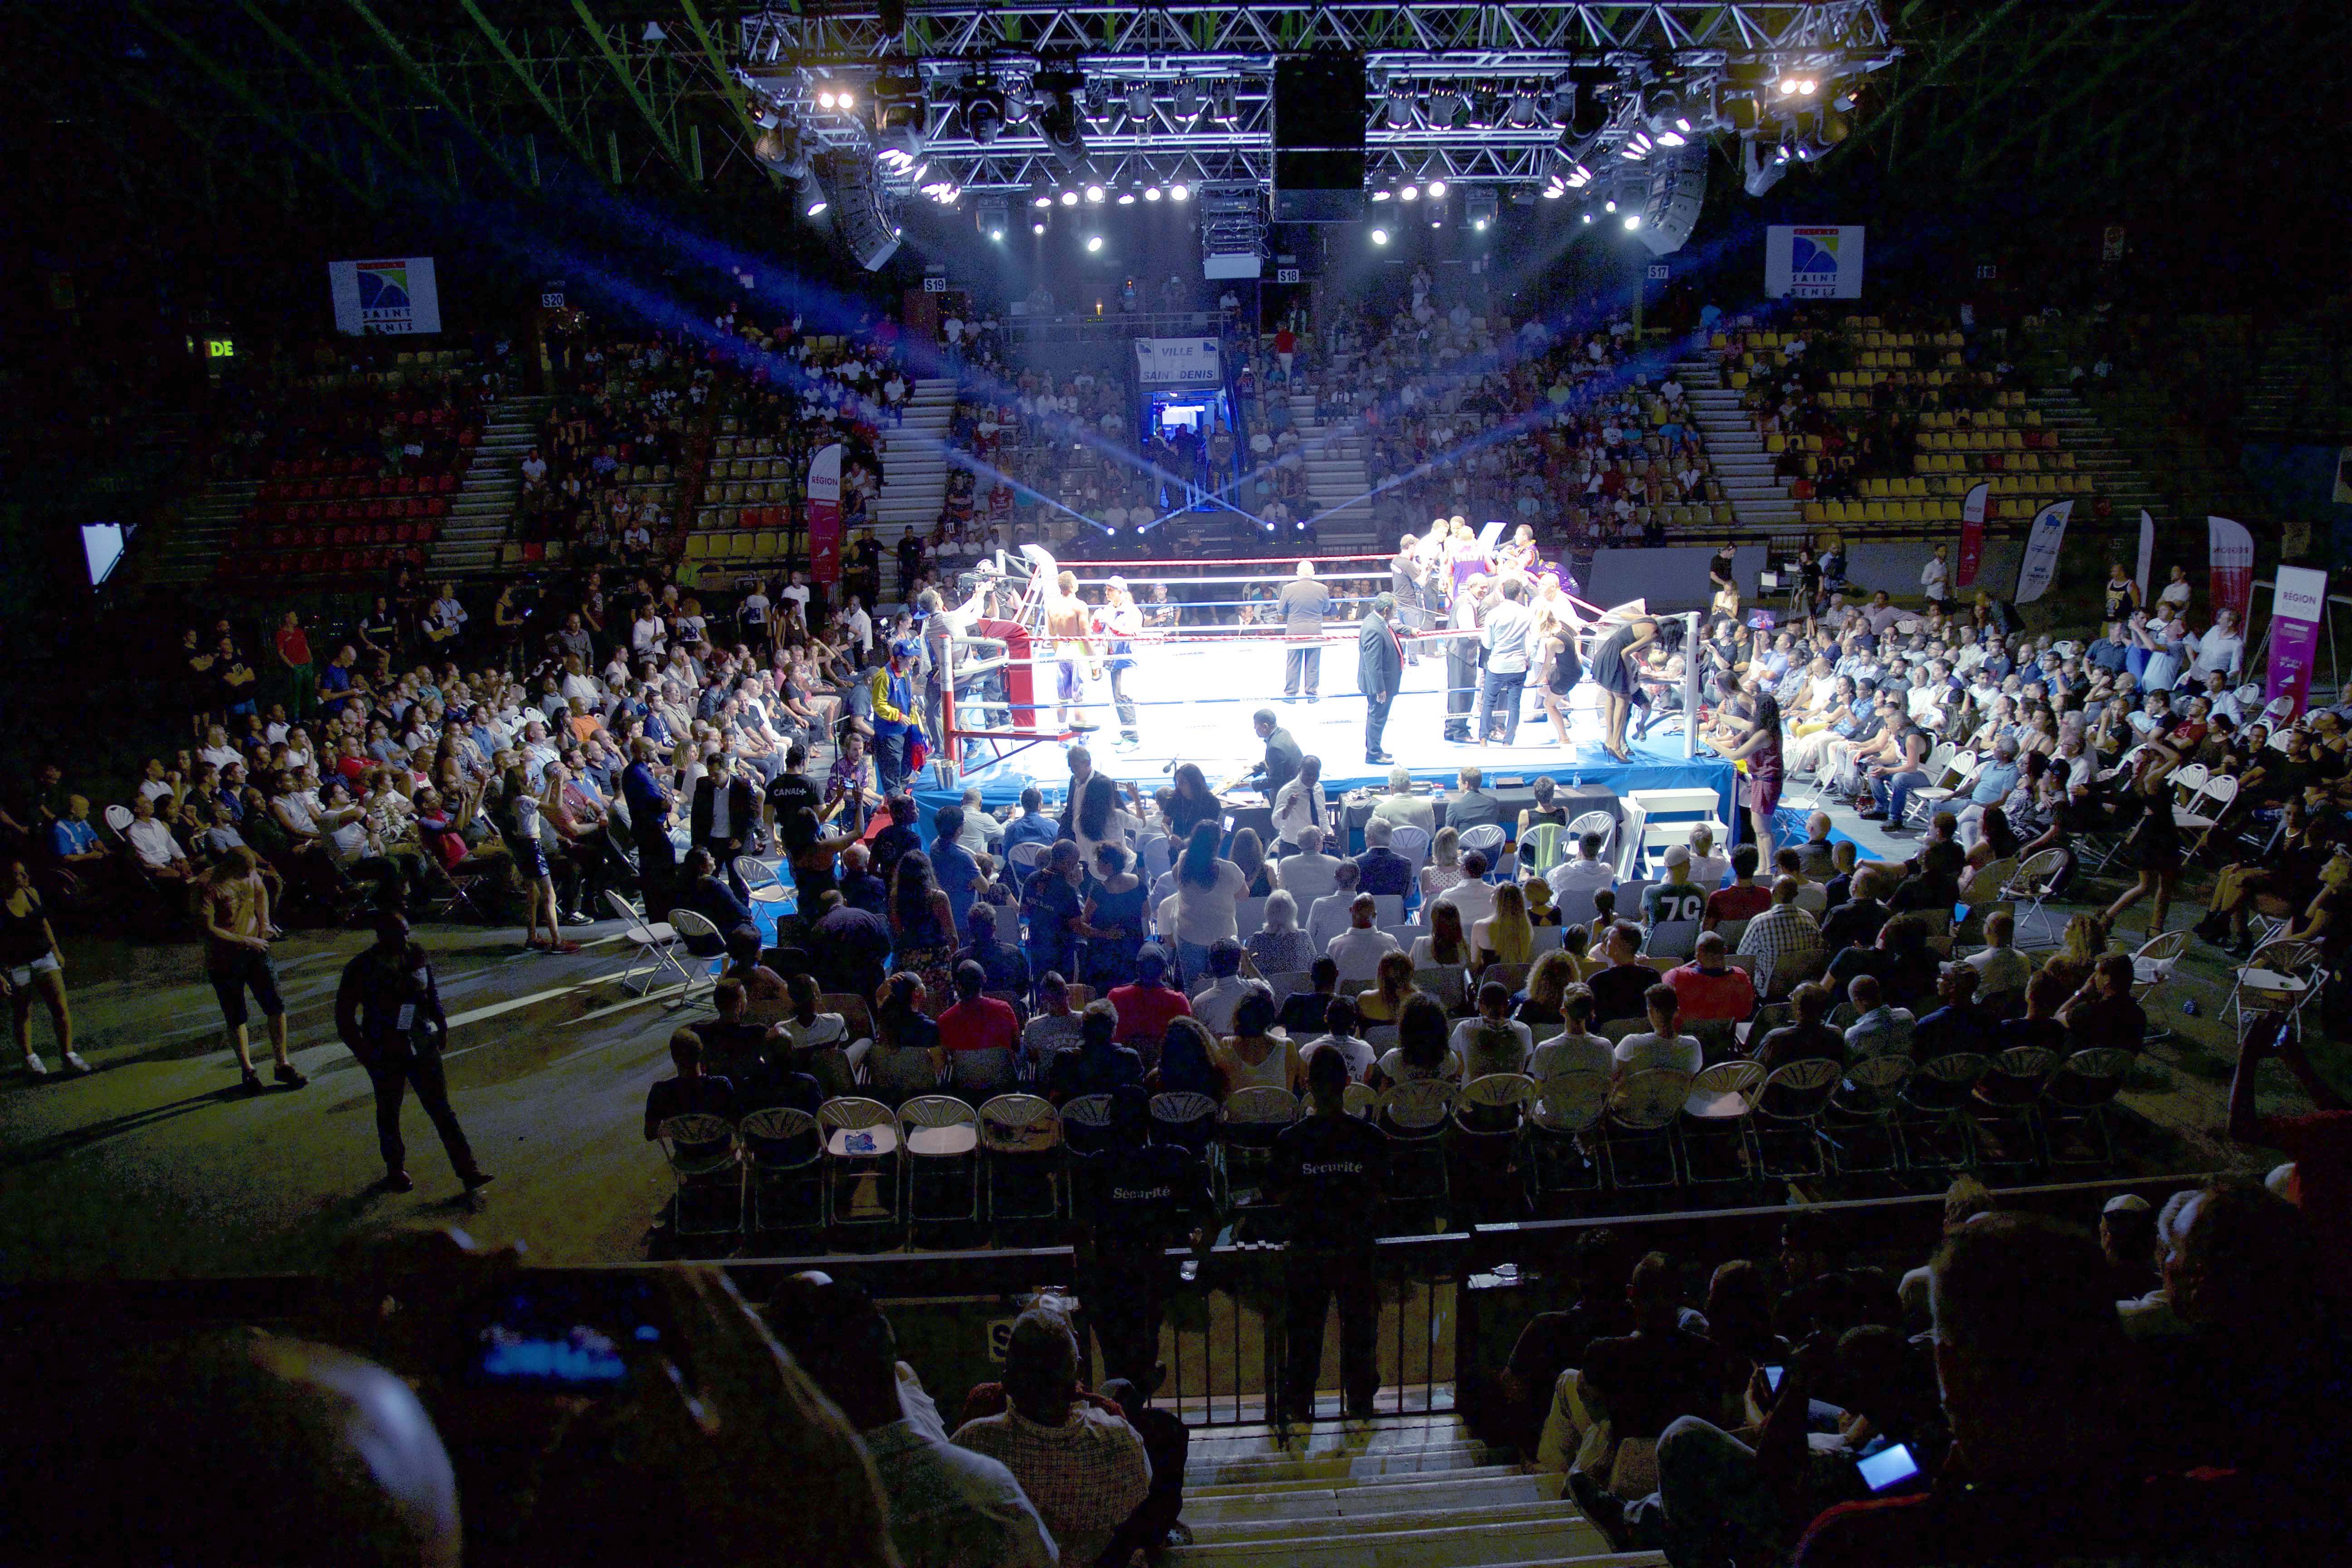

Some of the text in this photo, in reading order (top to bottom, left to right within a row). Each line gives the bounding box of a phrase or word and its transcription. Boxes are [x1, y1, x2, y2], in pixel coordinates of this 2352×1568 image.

[1280, 271, 1297, 281] S18
[1650, 267, 1666, 277] S17
[926, 279, 944, 290] S19
[544, 294, 563, 306] S20
[363, 309, 411, 318] SAINT
[1162, 347, 1193, 356] VILLE
[812, 474, 838, 486] RÉGION
[2283, 591, 2317, 604] RÉGION
[774, 788, 807, 796] CANAL+
